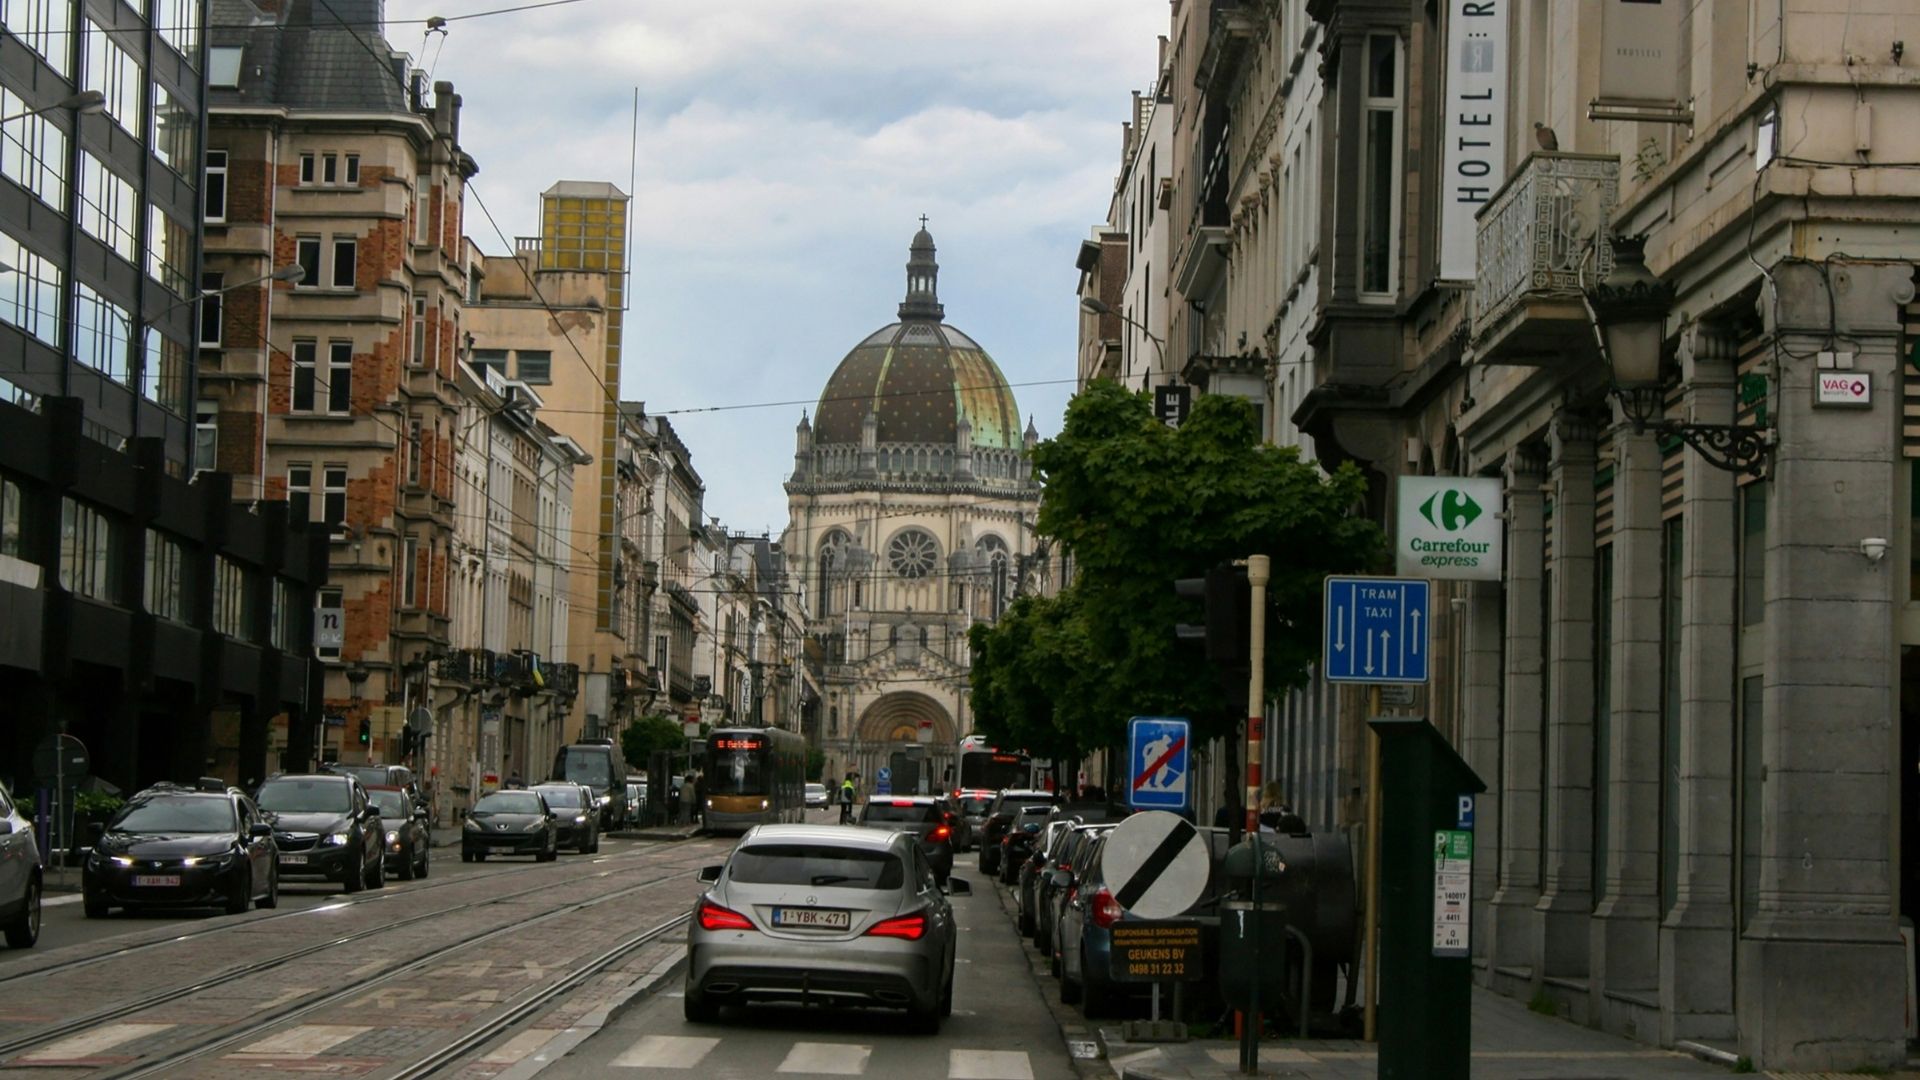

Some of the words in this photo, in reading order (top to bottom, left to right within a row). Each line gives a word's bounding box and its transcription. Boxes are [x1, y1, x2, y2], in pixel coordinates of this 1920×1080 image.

[1456, 88, 1493, 203] HOTEL
[1823, 379, 1849, 390] VAG
[1410, 537, 1490, 553] Carrefour
[1421, 555, 1479, 568] express
[1361, 588, 1397, 600] TRAM
[1364, 606, 1393, 618] TAXI
[1459, 796, 1473, 821] P
[1128, 949, 1170, 960] GEUKENS
[1172, 948, 1185, 959] BV
[1150, 963, 1160, 974] 31
[1162, 963, 1173, 974] 22
[1174, 963, 1184, 974] 32
